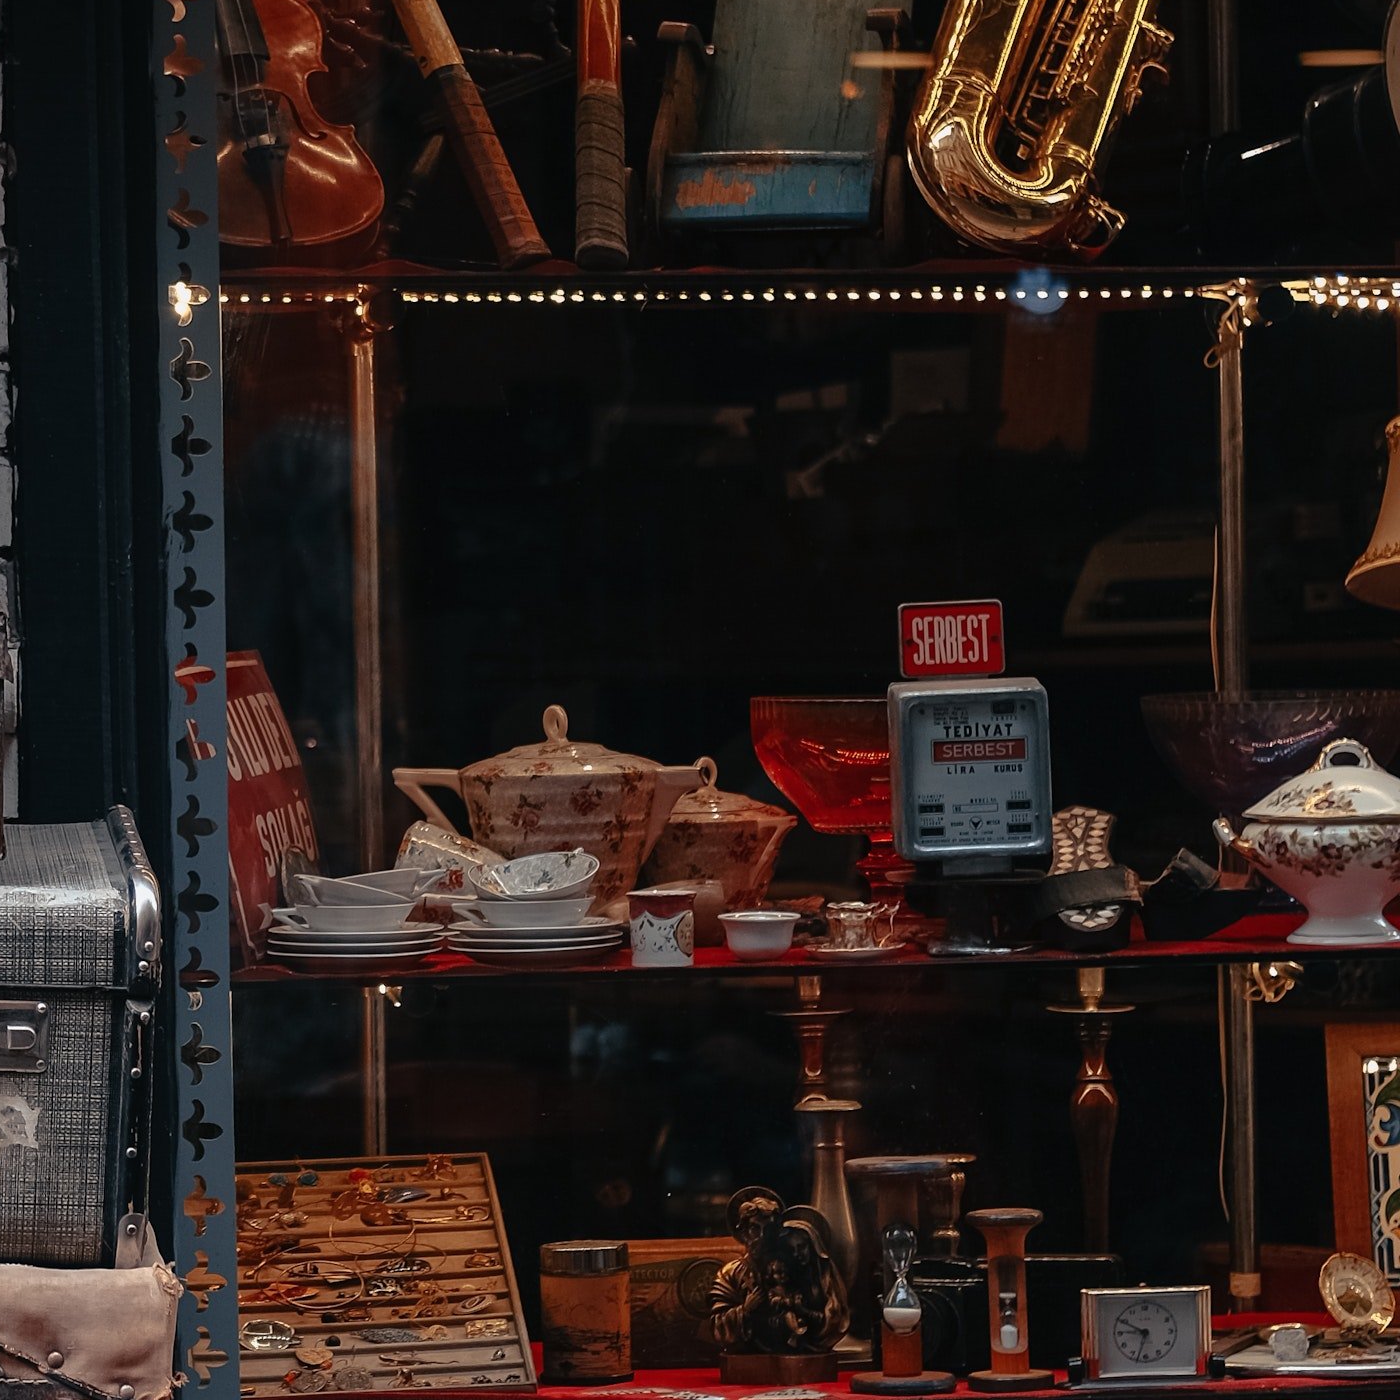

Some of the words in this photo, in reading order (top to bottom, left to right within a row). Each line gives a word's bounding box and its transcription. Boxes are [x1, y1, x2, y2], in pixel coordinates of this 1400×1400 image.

[911, 613, 990, 666] SERBEST
[943, 722, 1013, 738] TEDİYAT
[942, 742, 1016, 758] SERBEST
[632, 1268, 675, 1281] TECTOR
